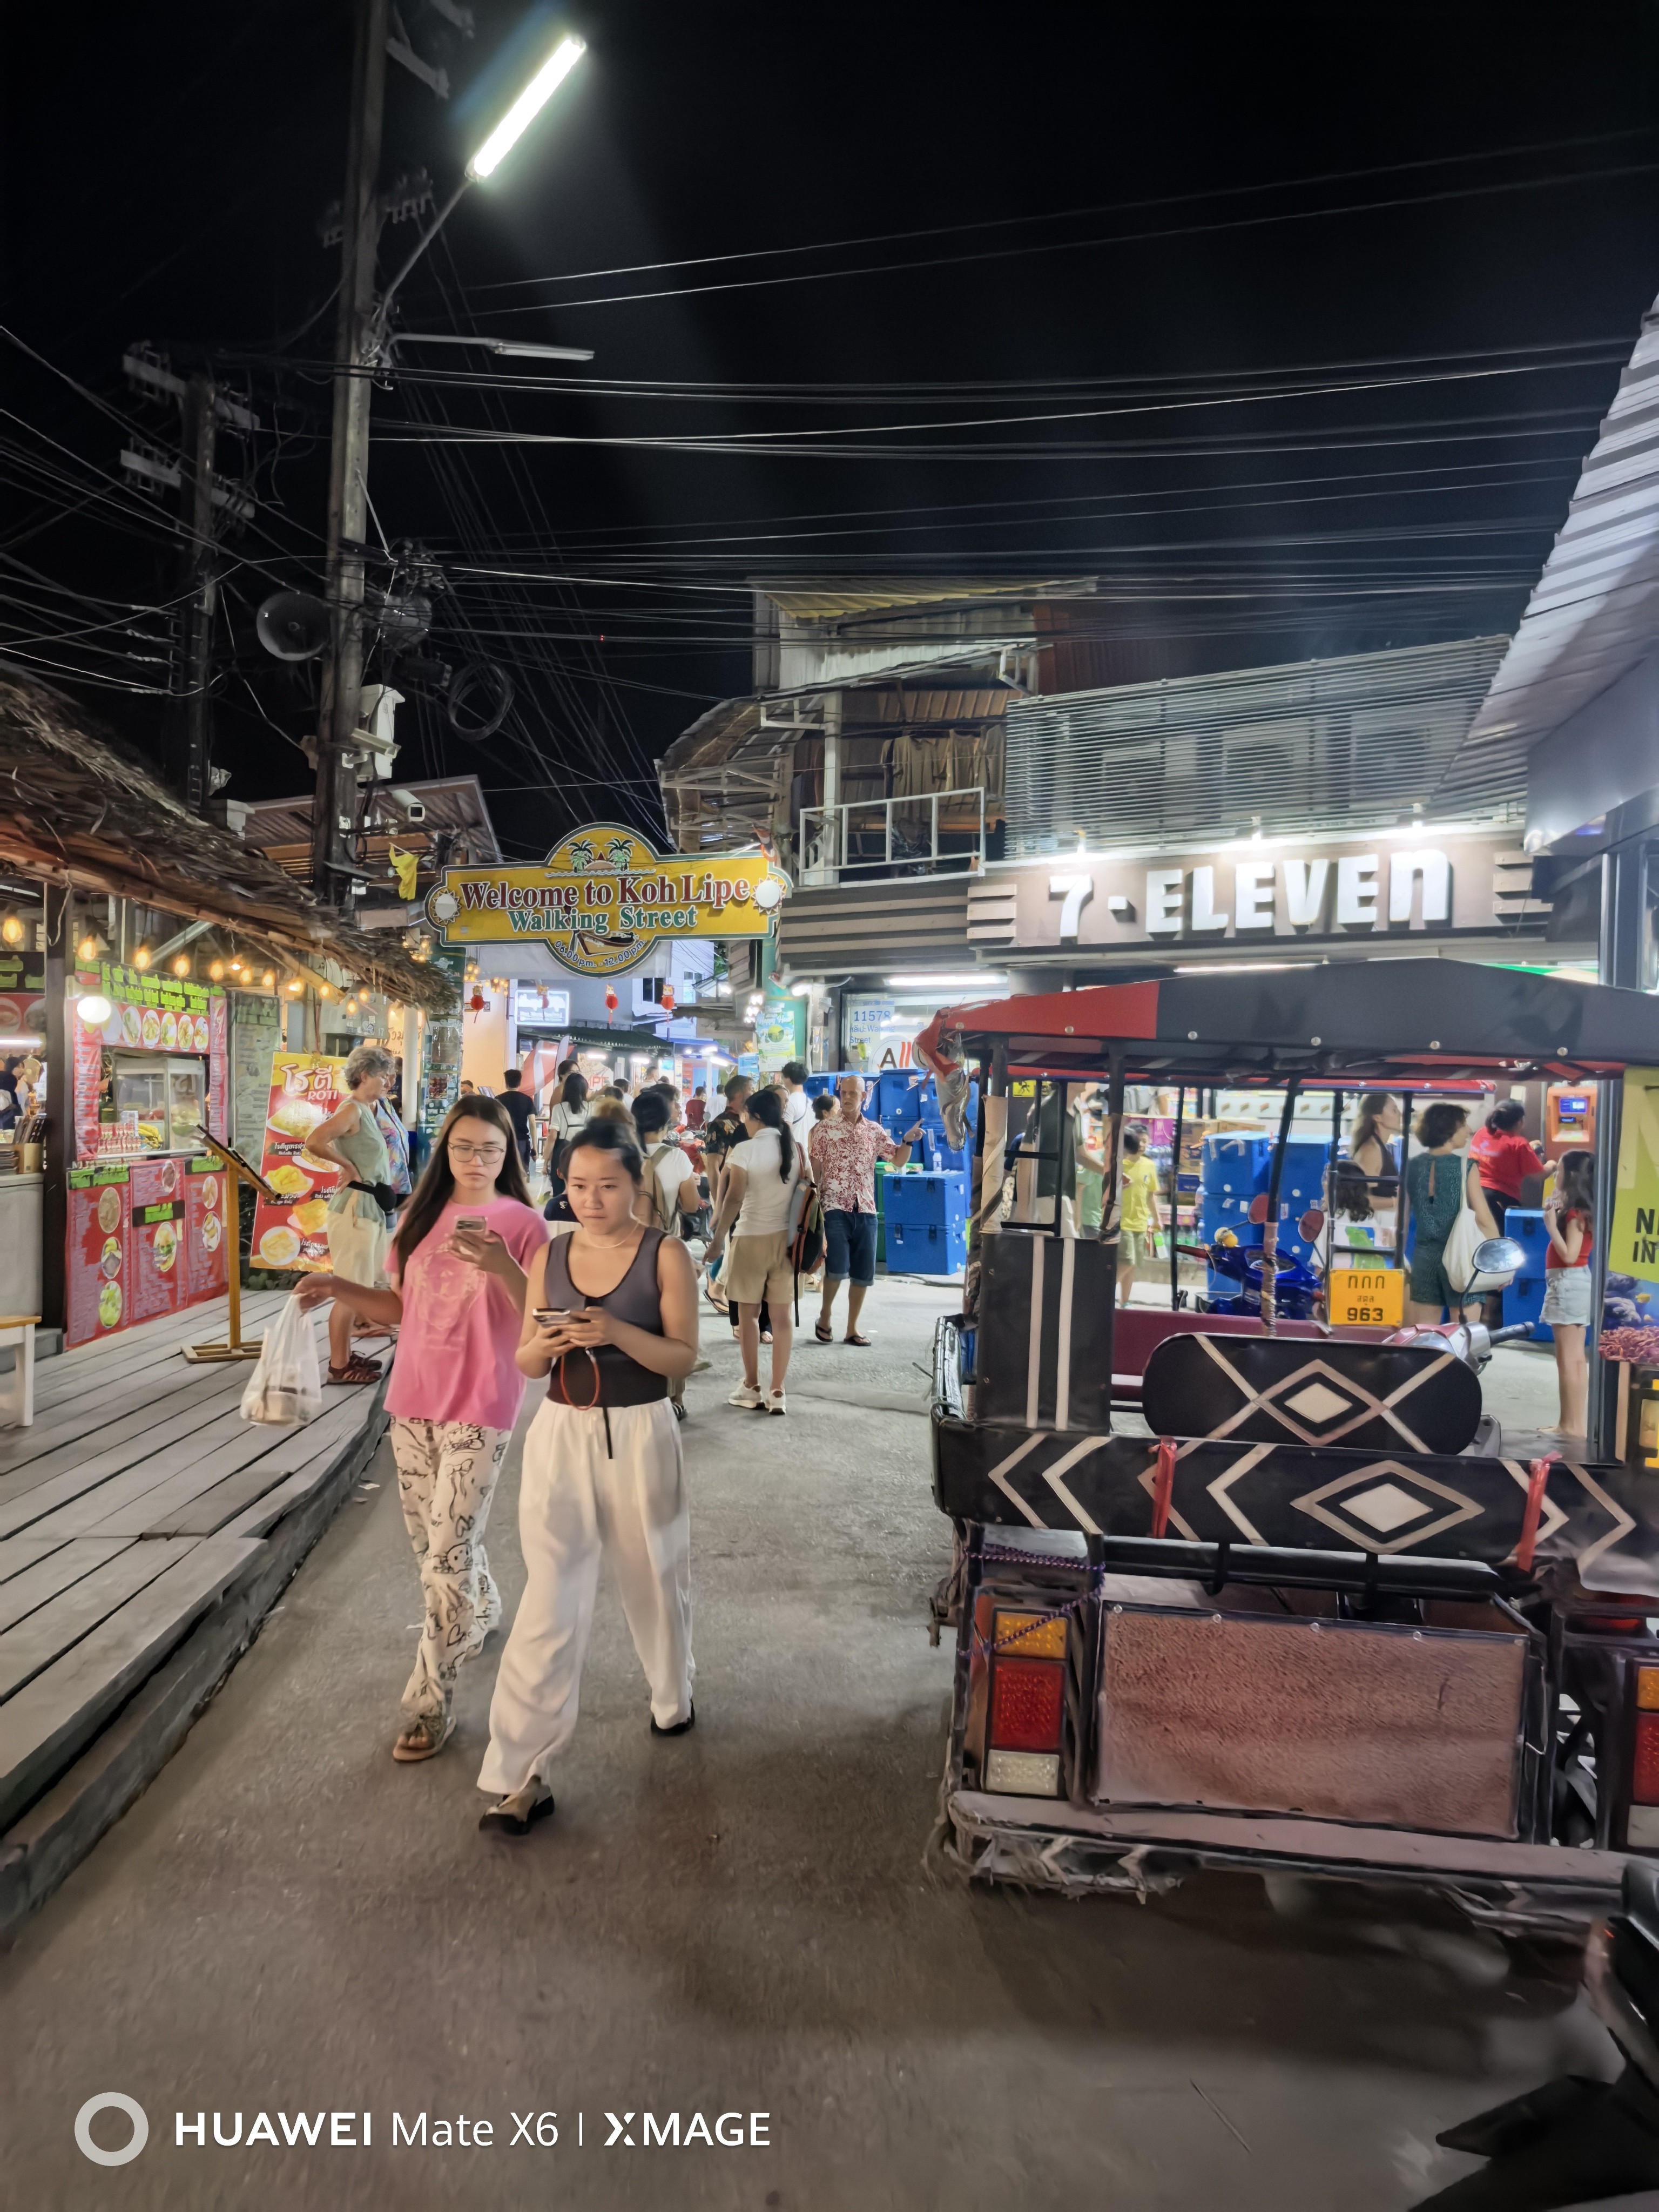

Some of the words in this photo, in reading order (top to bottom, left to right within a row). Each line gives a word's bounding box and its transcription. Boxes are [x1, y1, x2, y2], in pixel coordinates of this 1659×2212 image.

[460, 881, 579, 910] Welcome
[584, 879, 613, 906] to
[617, 874, 676, 905] Koh
[680, 873, 750, 908] Lipe
[508, 908, 609, 935] Walking
[620, 905, 698, 929] Street
[854, 1010, 891, 1022] 11578
[280, 1062, 334, 1094] โรตี
[308, 1089, 339, 1100] ROTI
[1635, 1207, 1659, 1235] N
[1347, 1307, 1384, 1321] 963
